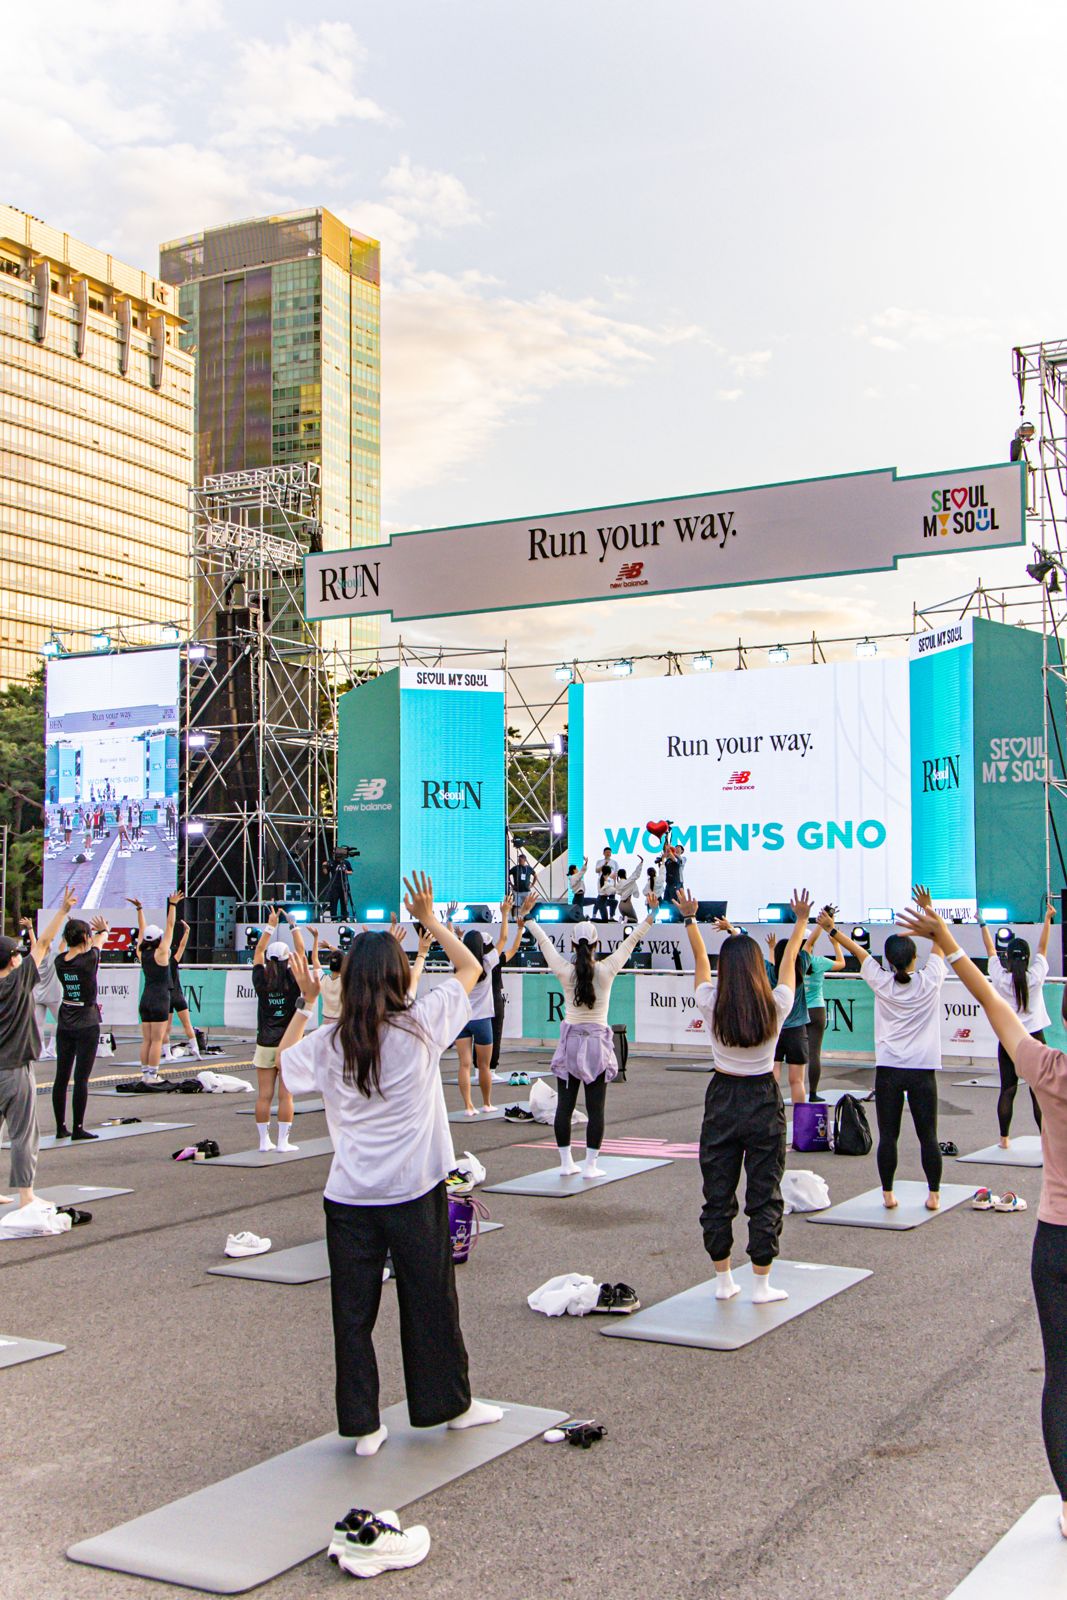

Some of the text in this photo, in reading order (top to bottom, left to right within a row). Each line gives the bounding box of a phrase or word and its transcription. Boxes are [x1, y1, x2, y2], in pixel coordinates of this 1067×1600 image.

[953, 507, 999, 535] SOUL
[528, 511, 737, 563] Run your way.
[318, 562, 381, 602] RUN
[623, 579, 649, 587] balance
[667, 732, 813, 762] Run your way.
[922, 754, 960, 792] RUN
[360, 802, 392, 811] balance
[421, 780, 484, 810] RUN
[439, 789, 465, 801] Seoul
[797, 819, 887, 851] GNO
[64, 973, 79, 981] Run
[111, 985, 130, 999] way.
[650, 991, 677, 1008] Run
[944, 1003, 980, 1021] your
